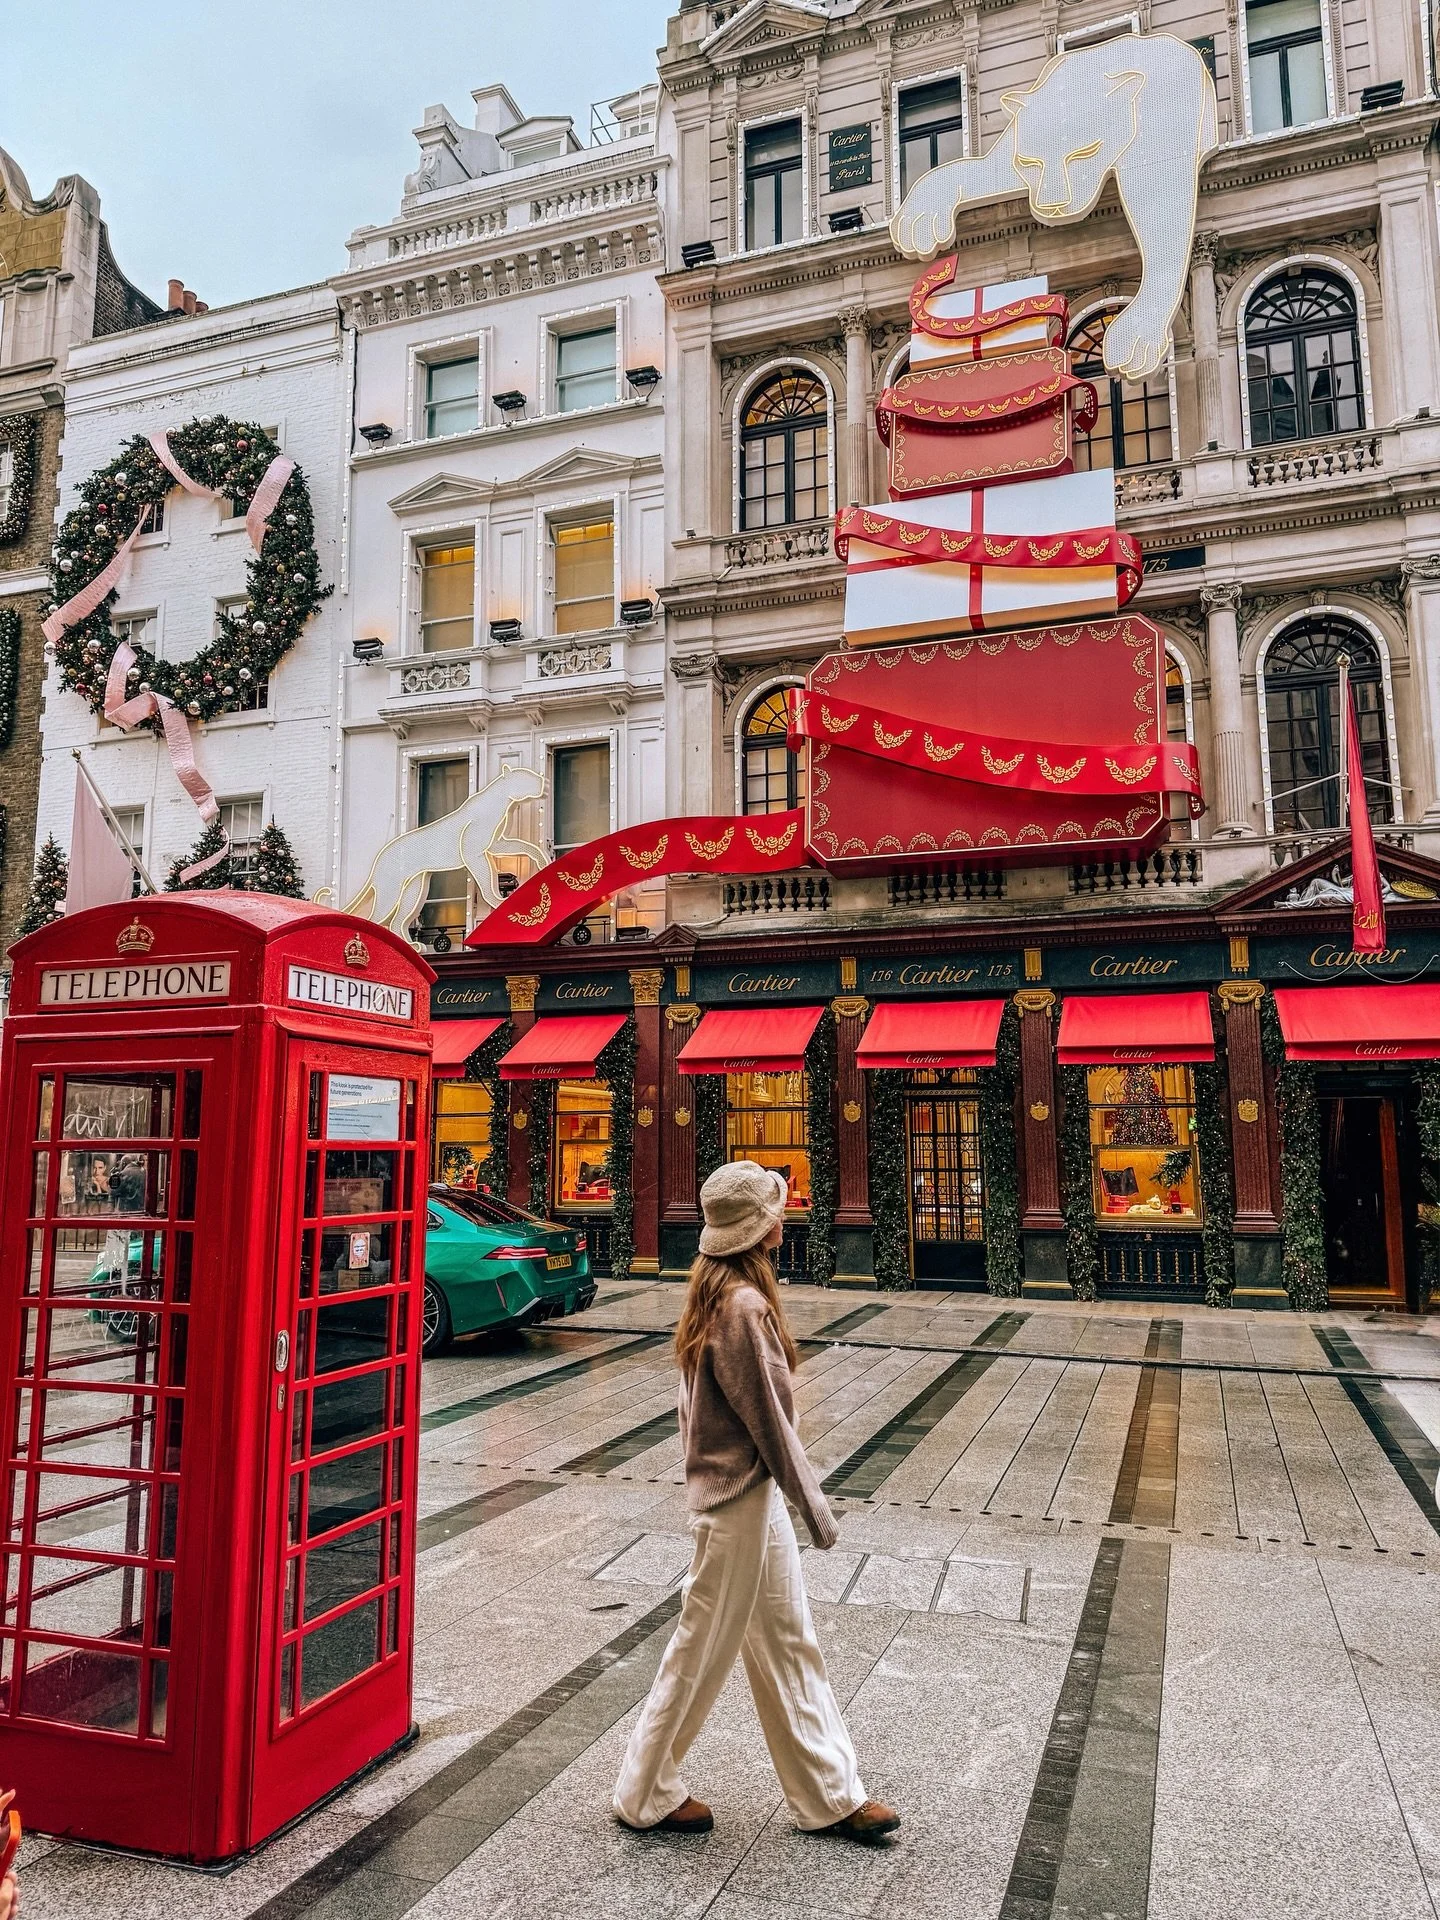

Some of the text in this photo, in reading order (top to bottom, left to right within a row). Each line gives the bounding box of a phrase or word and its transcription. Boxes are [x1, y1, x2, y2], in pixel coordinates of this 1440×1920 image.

[833, 133, 867, 147] Cartier
[836, 165, 865, 180] Paris
[1142, 557, 1171, 574] 175
[869, 963, 1013, 985] 176 Cartier 175
[1089, 954, 1179, 977] Cartier
[50, 964, 225, 1001] TELEPHONE
[555, 982, 613, 1000] Cartier
[727, 972, 801, 993] Cartier
[292, 970, 408, 1016] TELEPHONE
[436, 987, 492, 1005] Cartier
[1112, 1047, 1156, 1059] Cartier
[1355, 1042, 1402, 1055] Cartier
[723, 1059, 758, 1069] Cartier
[905, 1053, 945, 1064] Cartier
[531, 1064, 563, 1075] Cartier
